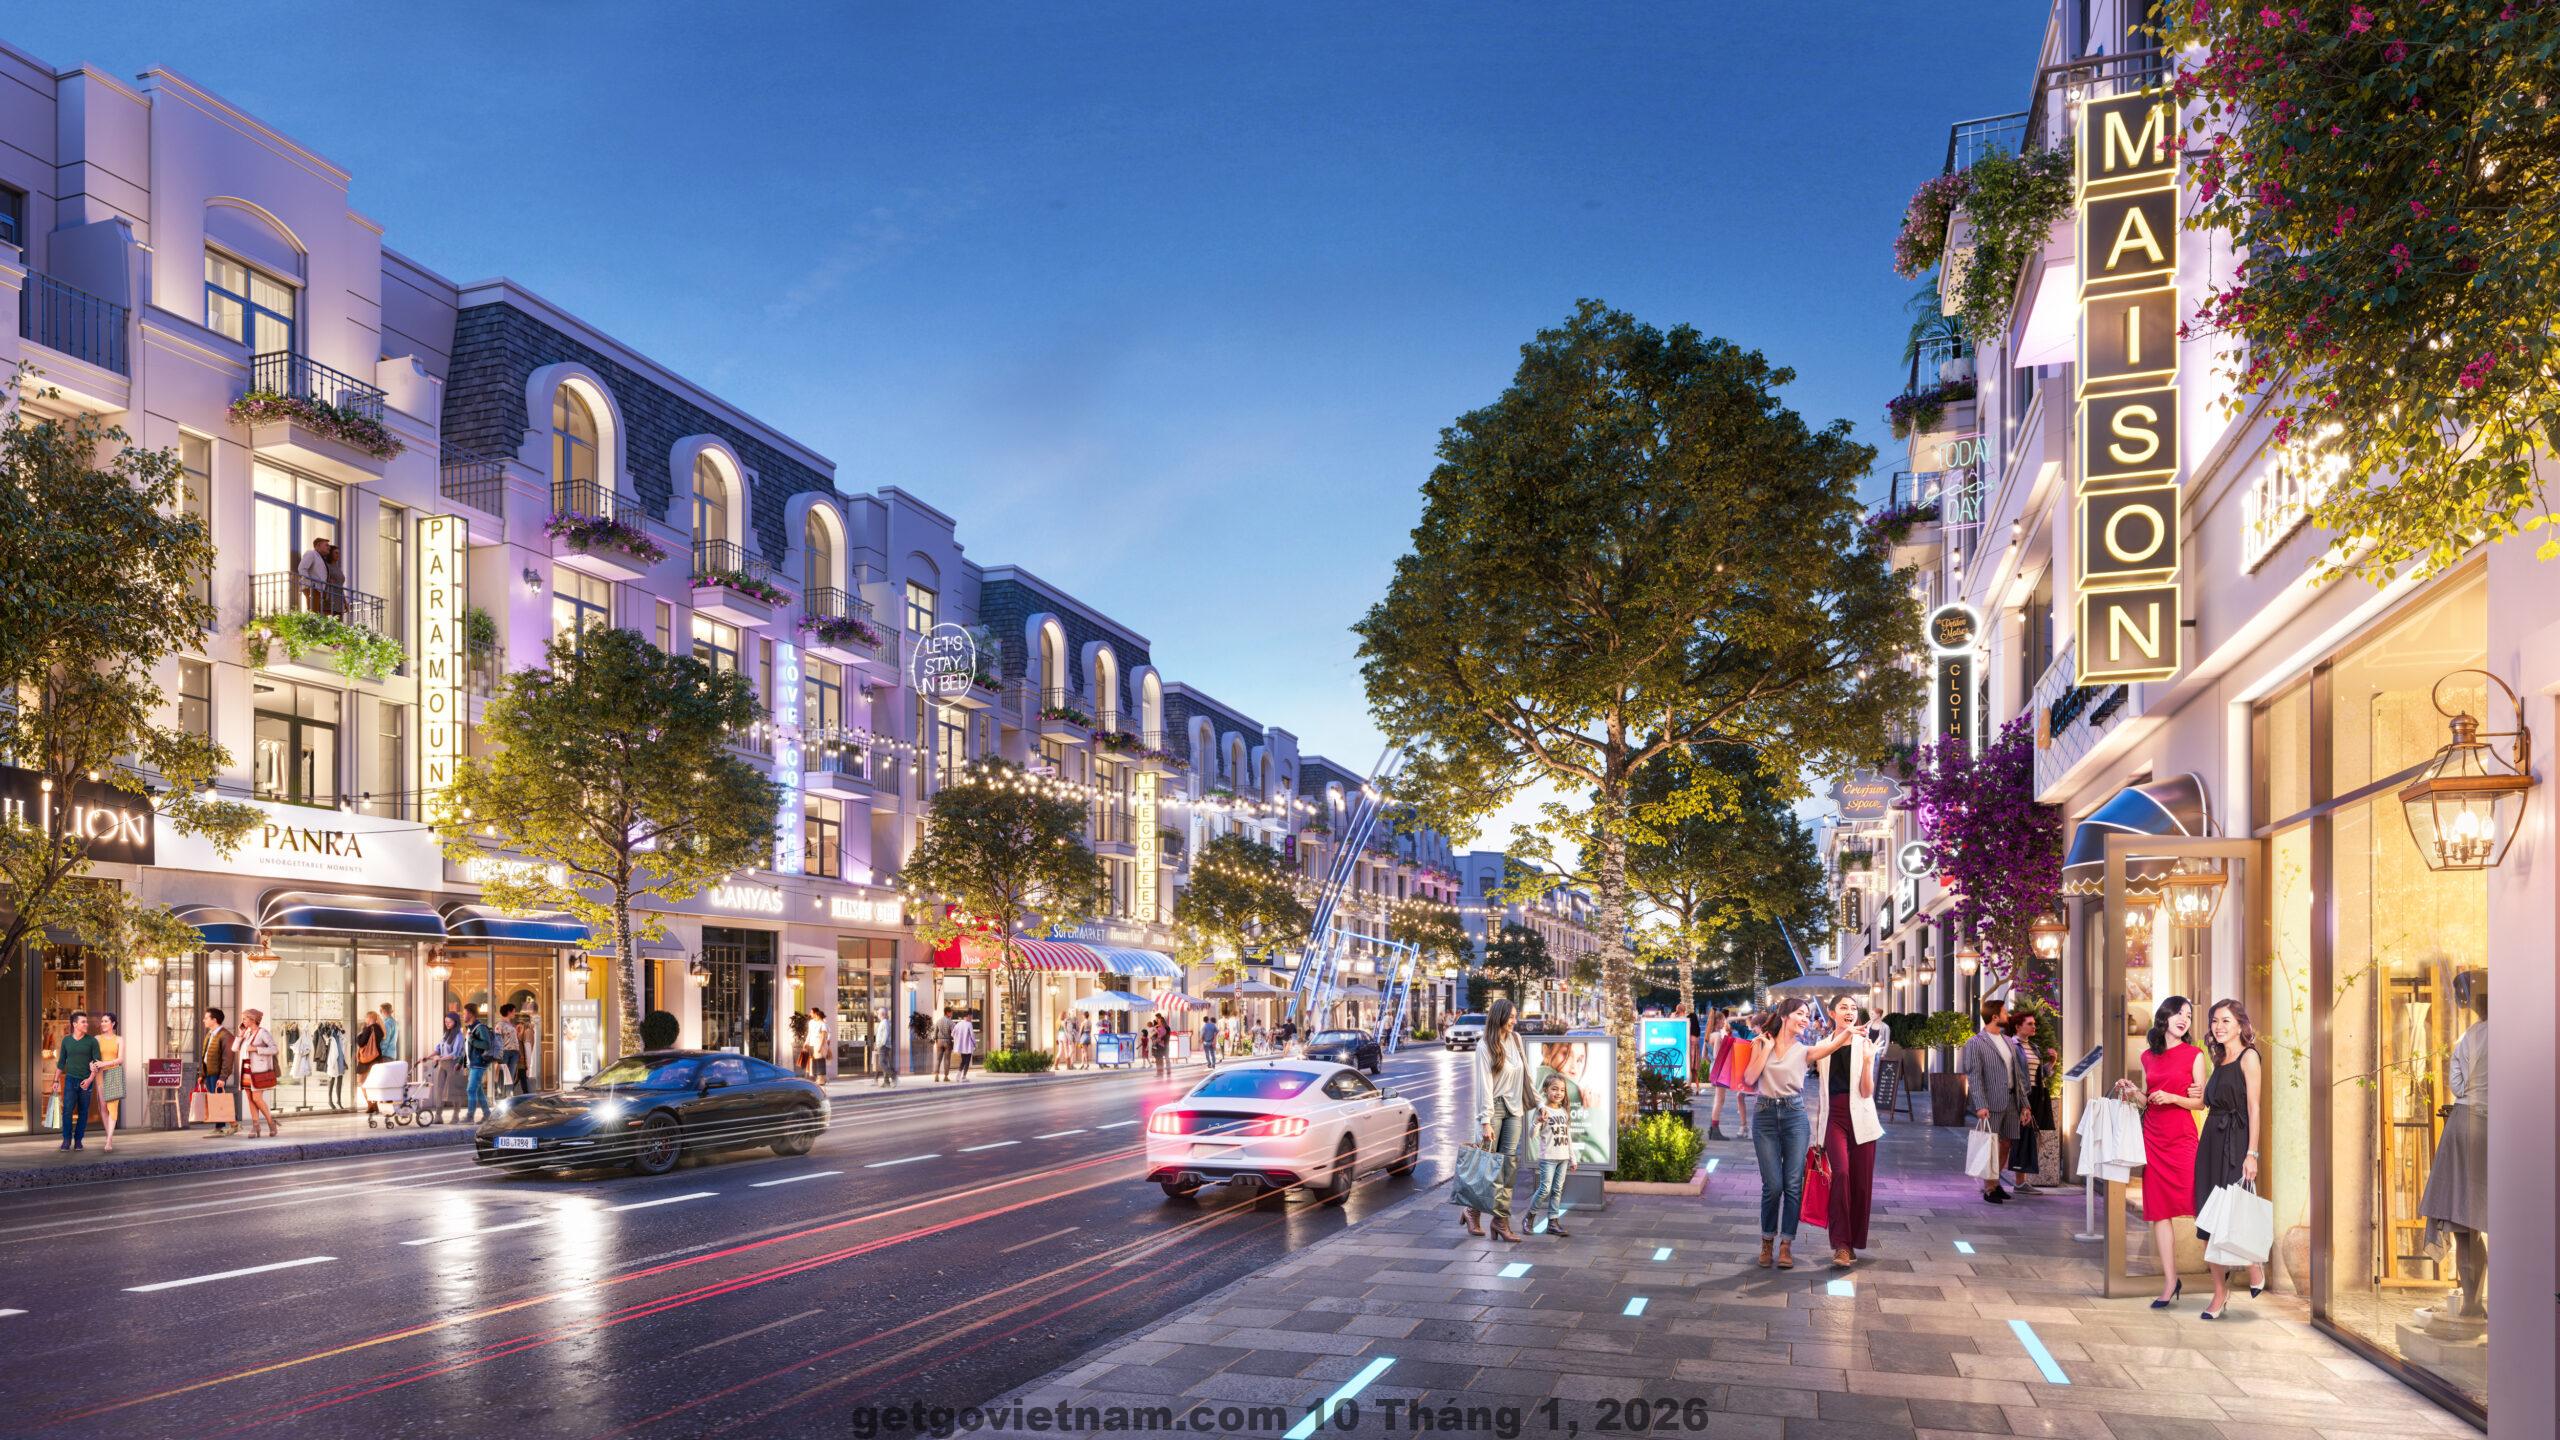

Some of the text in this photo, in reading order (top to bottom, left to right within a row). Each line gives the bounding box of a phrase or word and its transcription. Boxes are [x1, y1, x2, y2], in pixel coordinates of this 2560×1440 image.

[2103, 104, 2166, 662] MAISON
[1937, 433, 1996, 469] TODAY
[1947, 495, 1983, 524] DAY
[427, 519, 445, 800] PARAMOUN
[925, 635, 963, 654] LET'S
[924, 655, 963, 675] STAY
[785, 644, 799, 725] LOVE
[940, 672, 969, 692] BED
[263, 823, 363, 858] PANRA
[326, 864, 363, 873] MOMENTS
